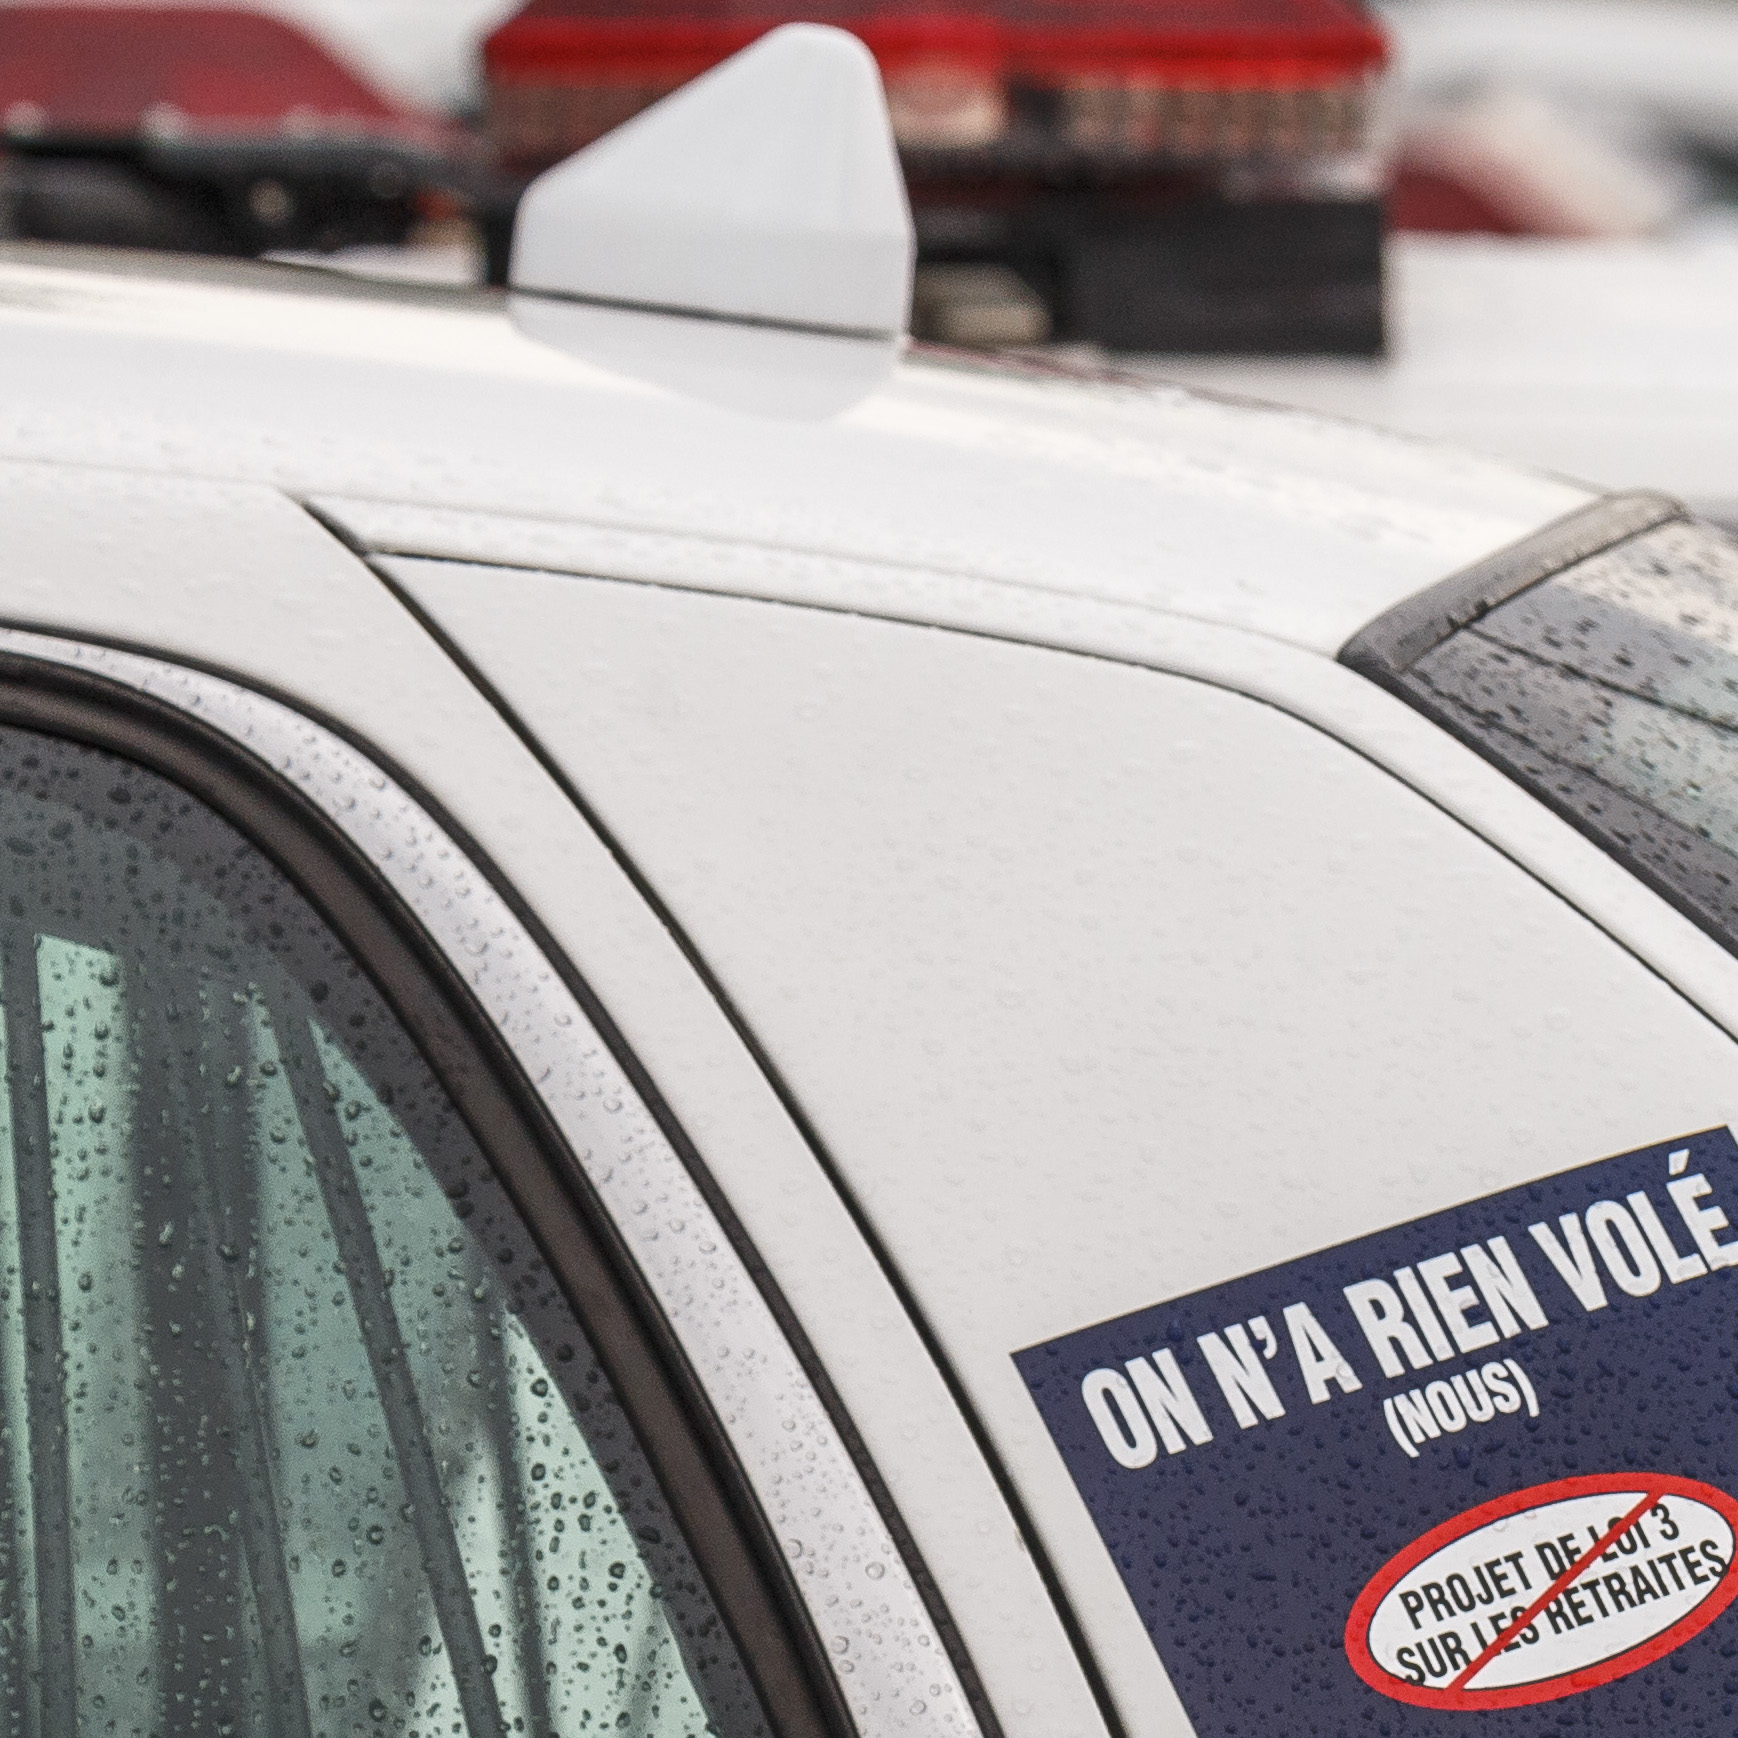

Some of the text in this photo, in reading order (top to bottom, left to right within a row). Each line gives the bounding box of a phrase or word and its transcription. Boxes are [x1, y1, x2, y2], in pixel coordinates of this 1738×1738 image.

[1081, 1347, 1213, 1469] ON
[1196, 1301, 1363, 1430] N'A
[1342, 1235, 1549, 1379] RIEN
[1383, 1358, 1540, 1458] (NOUS)
[1396, 1540, 1729, 1686] SUR LES RETRAITES
[1399, 1503, 1680, 1630] PROJET DE LOI 3
